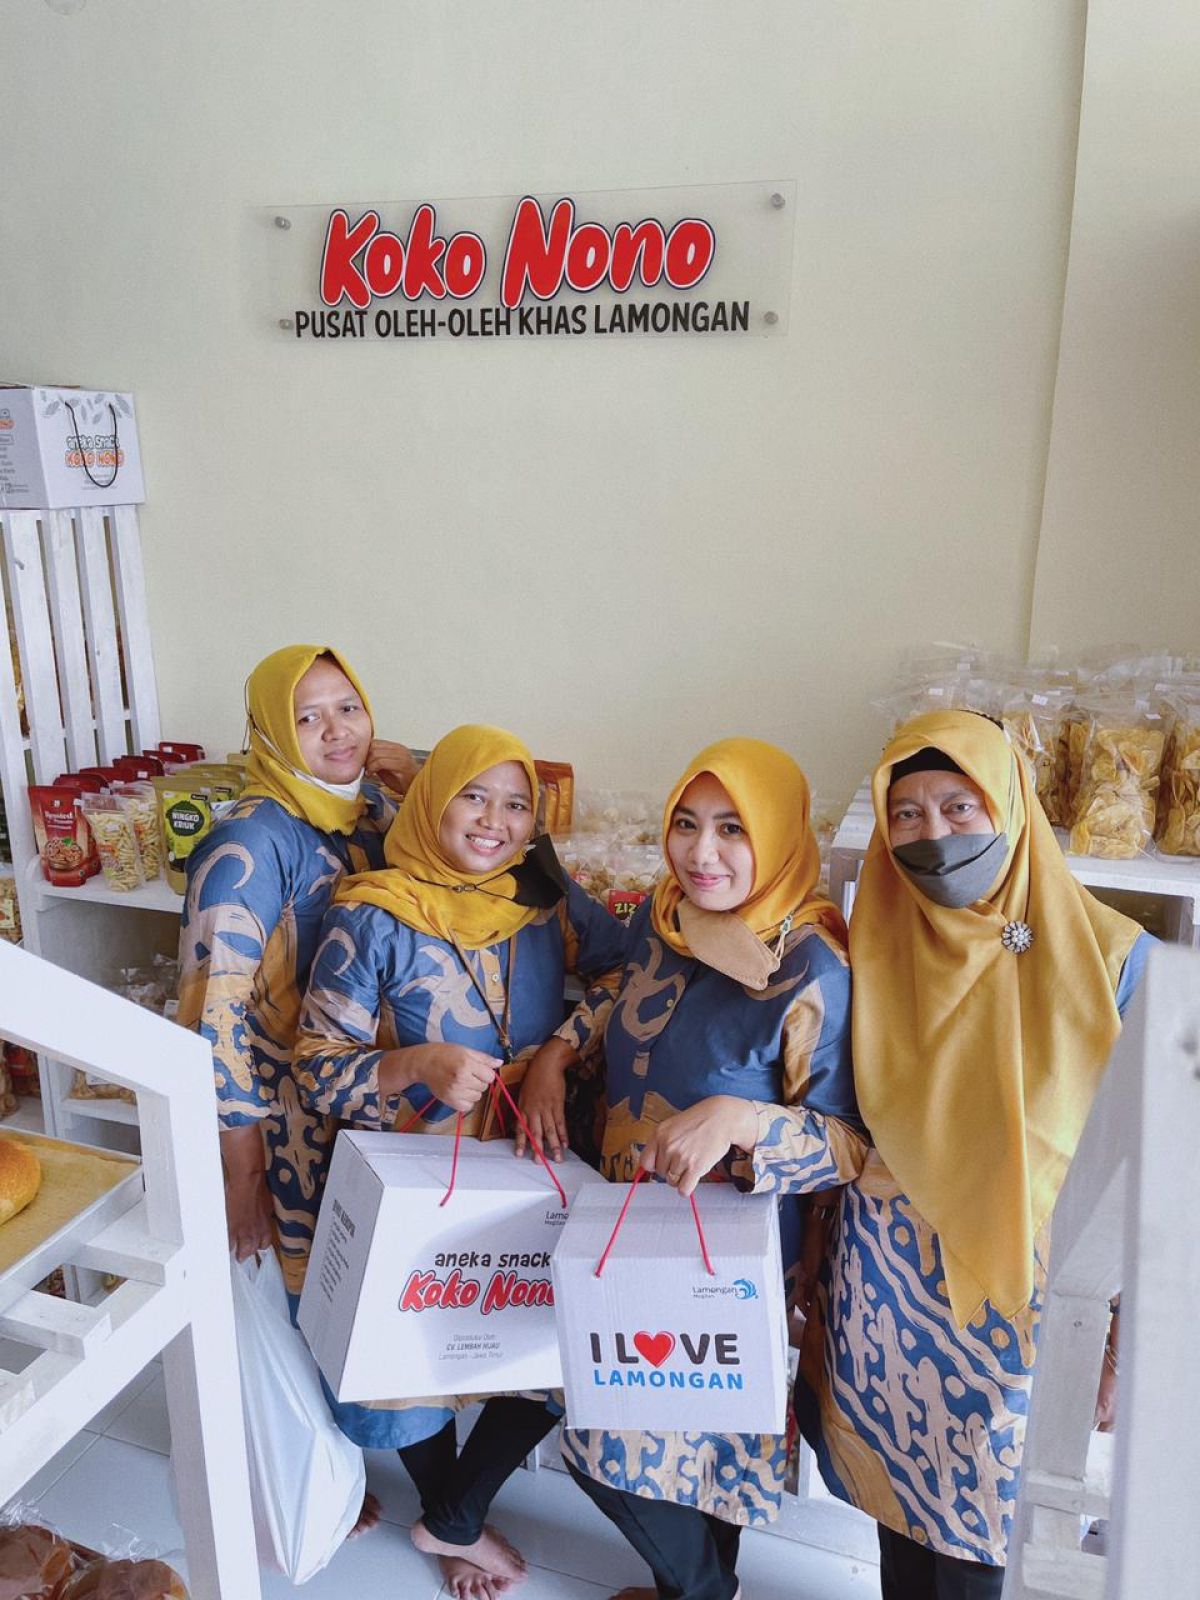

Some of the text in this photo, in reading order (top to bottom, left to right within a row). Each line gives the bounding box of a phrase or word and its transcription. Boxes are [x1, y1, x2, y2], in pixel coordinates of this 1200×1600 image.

[320, 195, 716, 311] Koko Nono
[295, 301, 750, 338] PUSAT OLEH-OLEH KHAS LAMONGAN
[545, 1210, 570, 1220] Lamo
[434, 1250, 551, 1268] aneka snack
[399, 1268, 481, 1312] Koko
[589, 1332, 602, 1364] I
[593, 1369, 744, 1390] LAMONGAN
